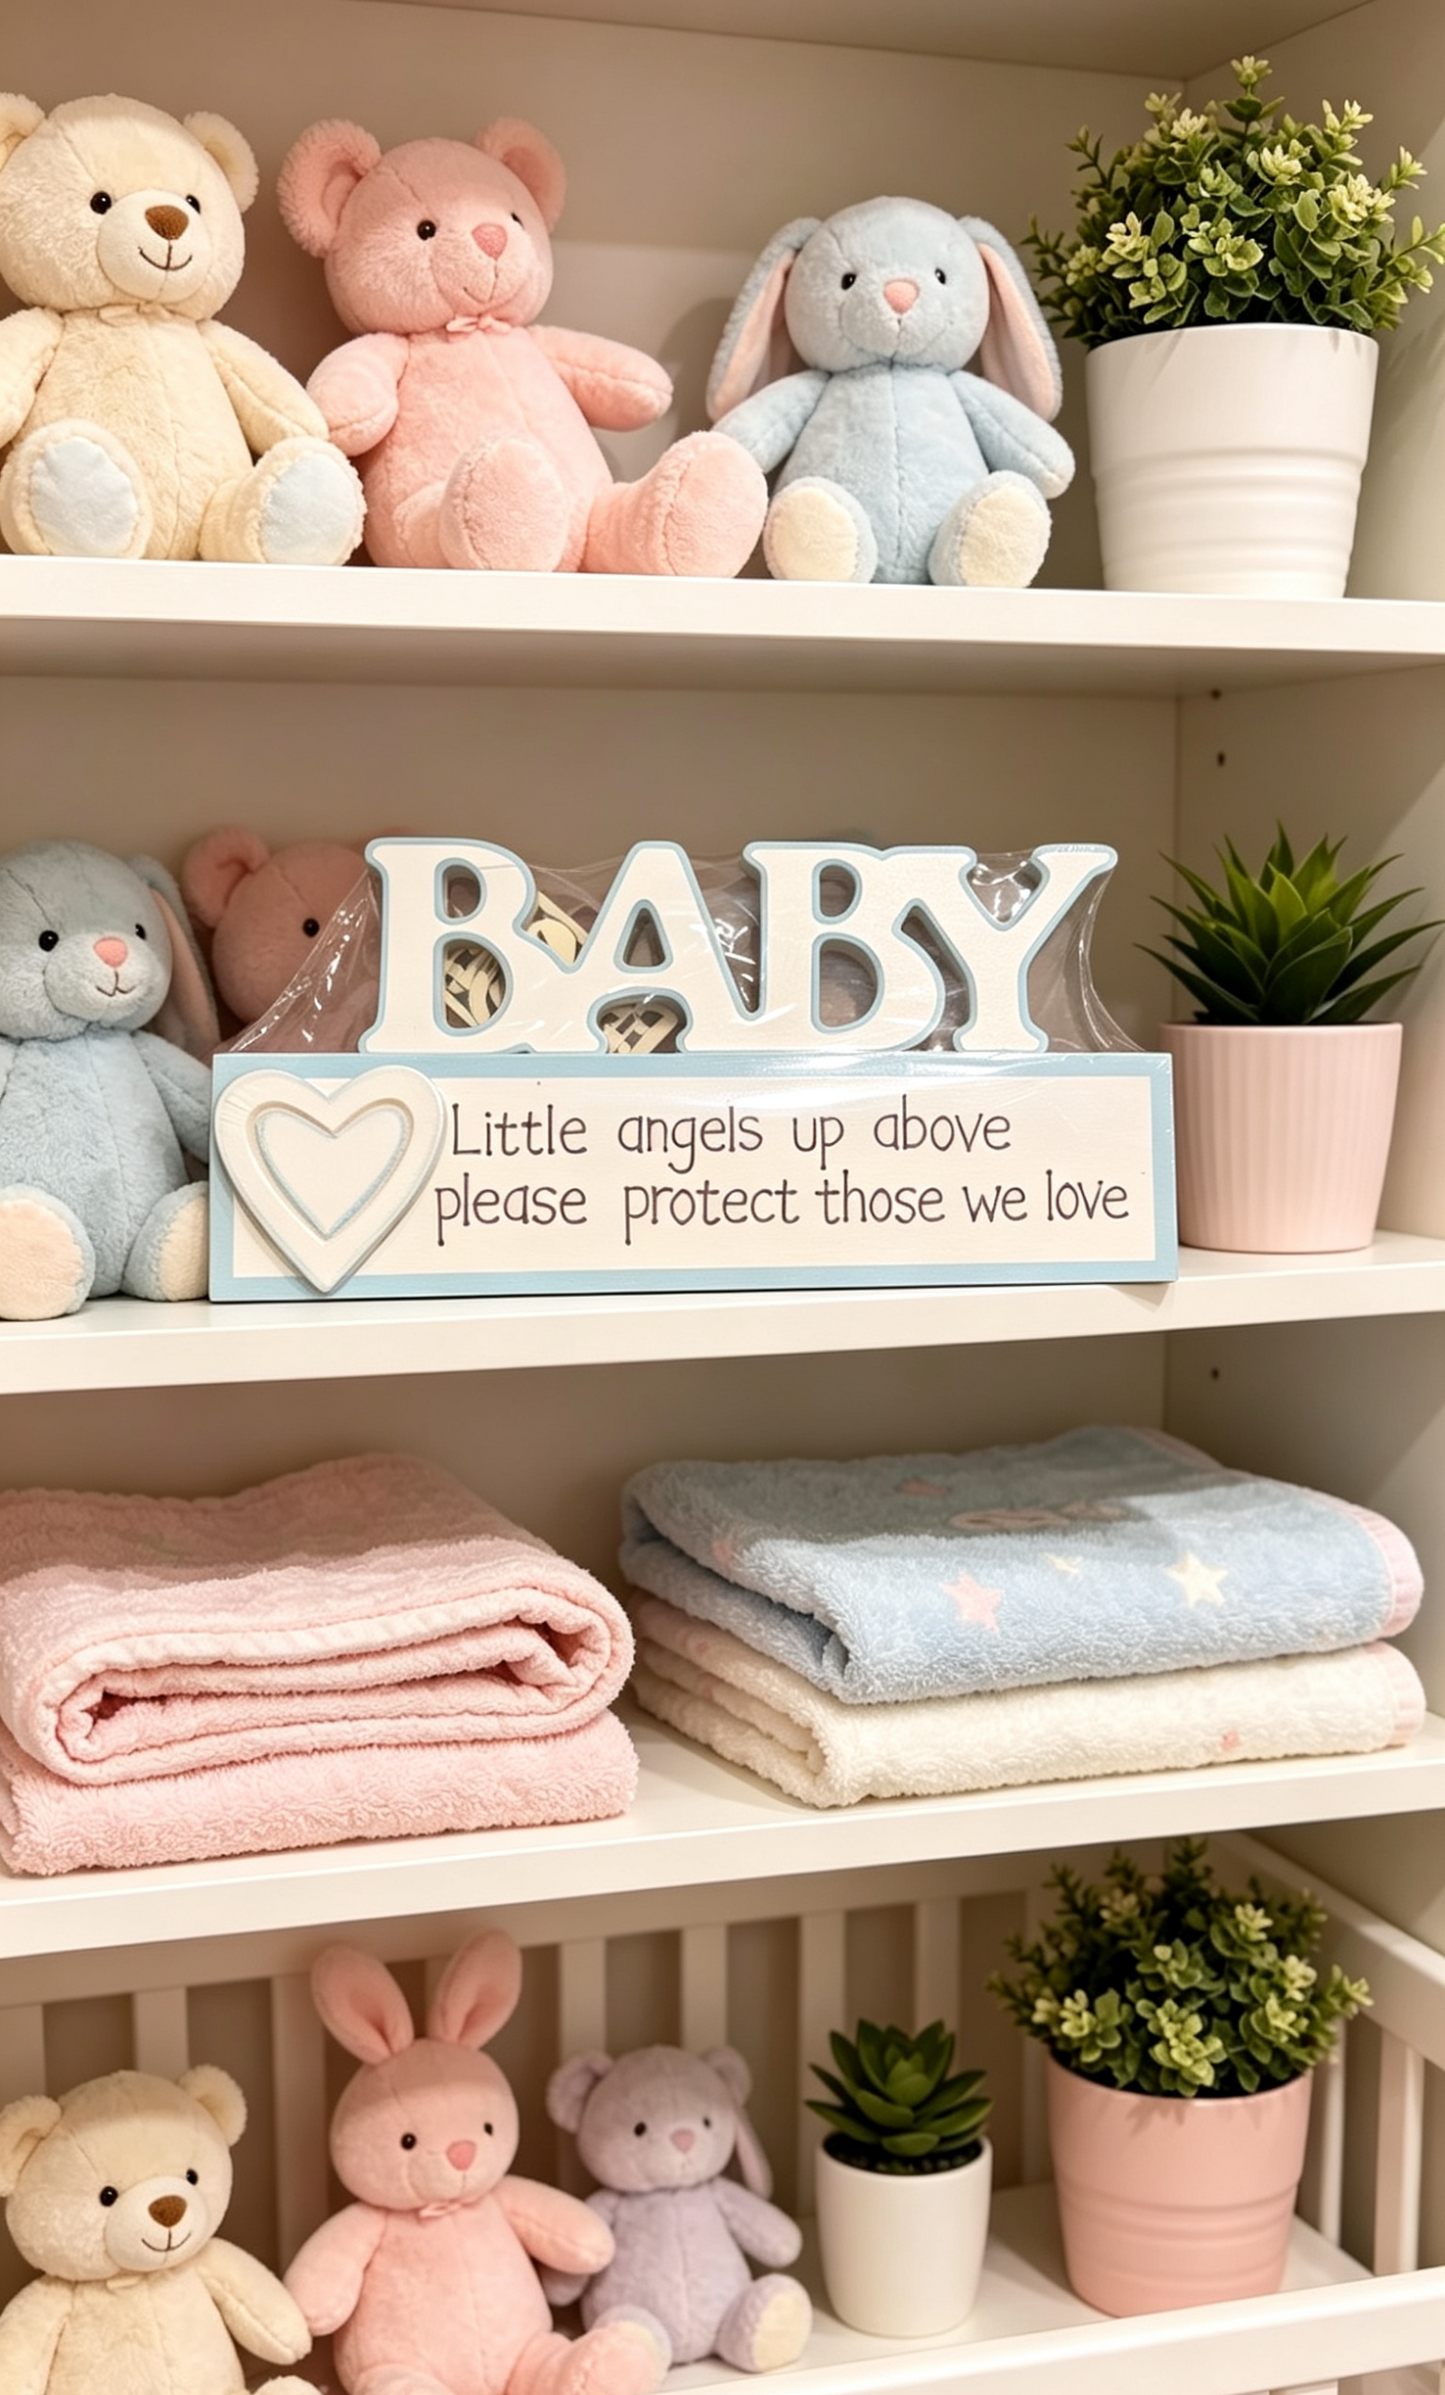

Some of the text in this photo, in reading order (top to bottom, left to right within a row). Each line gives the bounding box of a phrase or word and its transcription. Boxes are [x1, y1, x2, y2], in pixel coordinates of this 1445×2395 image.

[359, 837, 1118, 1053] BABY
[451, 1093, 1012, 1176] Little angels up above
[434, 1167, 1130, 1248] please protect those we love
